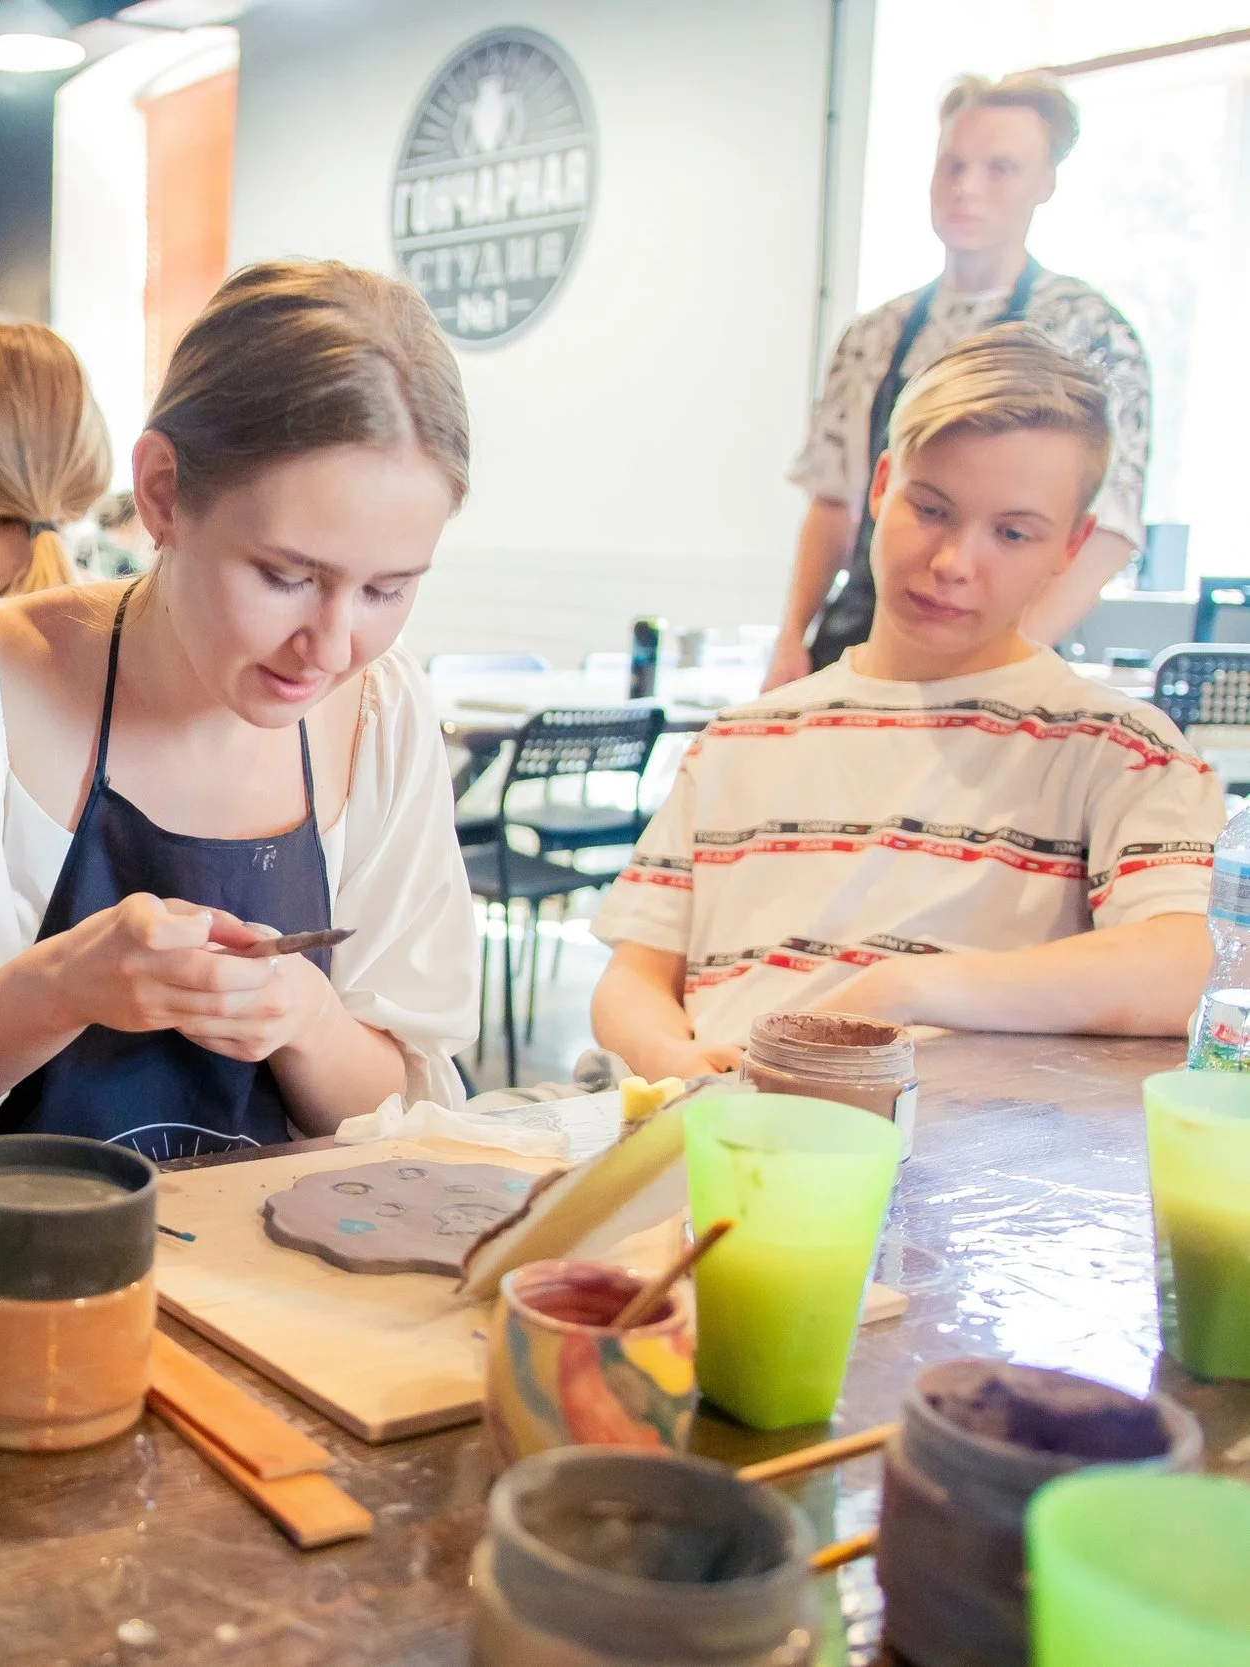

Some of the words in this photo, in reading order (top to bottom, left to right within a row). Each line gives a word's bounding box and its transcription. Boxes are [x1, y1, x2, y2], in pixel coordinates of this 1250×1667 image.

[394, 148, 587, 237] ГОНЧАРНАЯ
[410, 231, 565, 293] СТУДИЯ
[1145, 855, 1207, 868] TOMMY
[1158, 841, 1211, 853] JEANS
